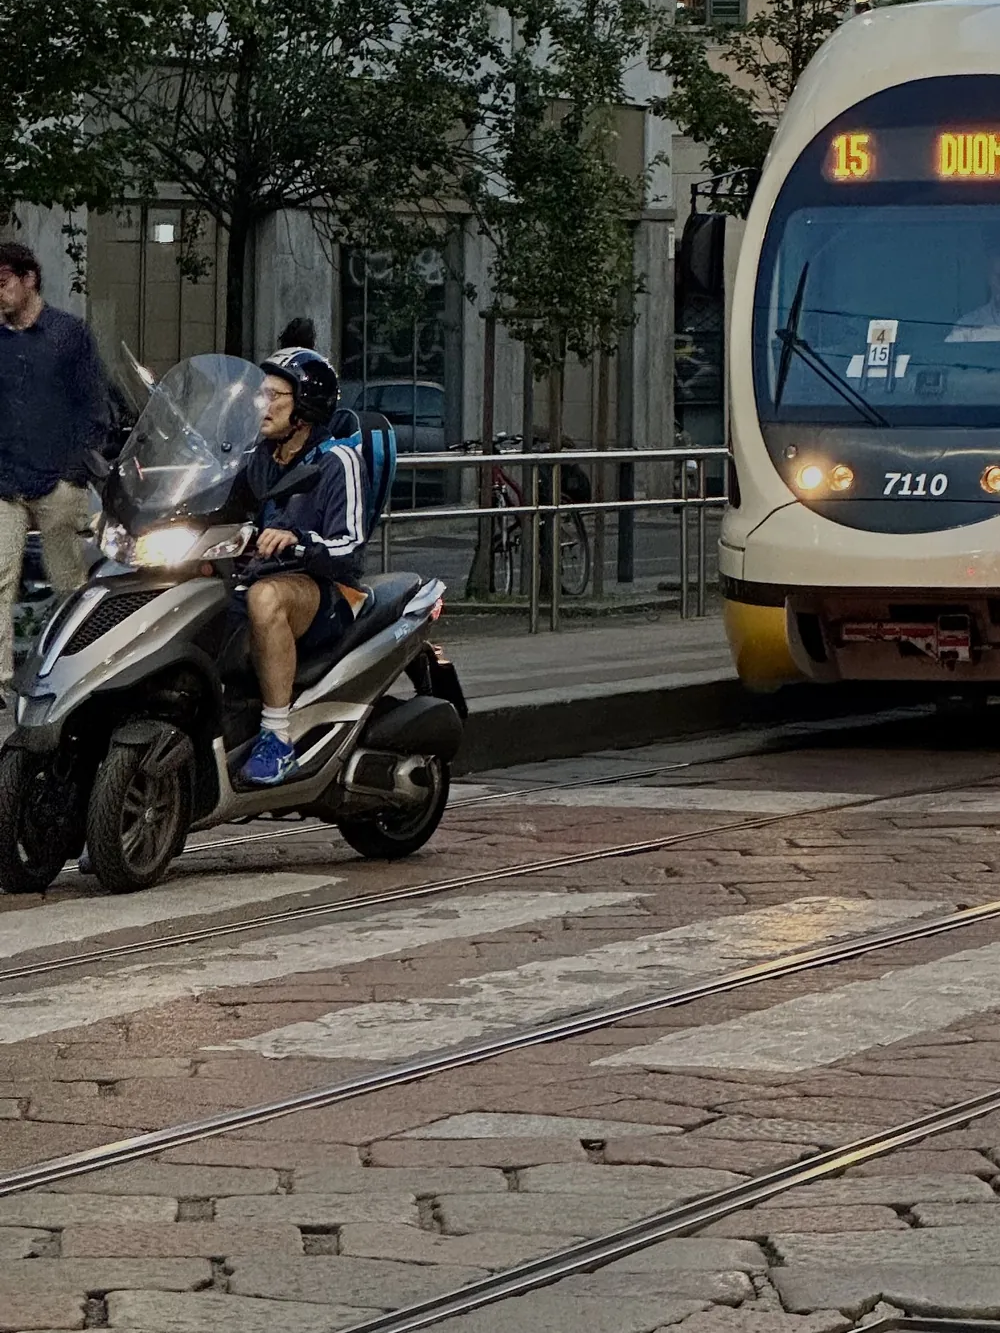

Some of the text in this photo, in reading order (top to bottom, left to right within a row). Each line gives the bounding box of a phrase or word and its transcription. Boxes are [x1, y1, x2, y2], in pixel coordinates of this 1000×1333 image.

[833, 133, 870, 177] 15
[876, 329, 886, 344] 4
[871, 347, 887, 361] 15
[883, 472, 948, 496] 7110
